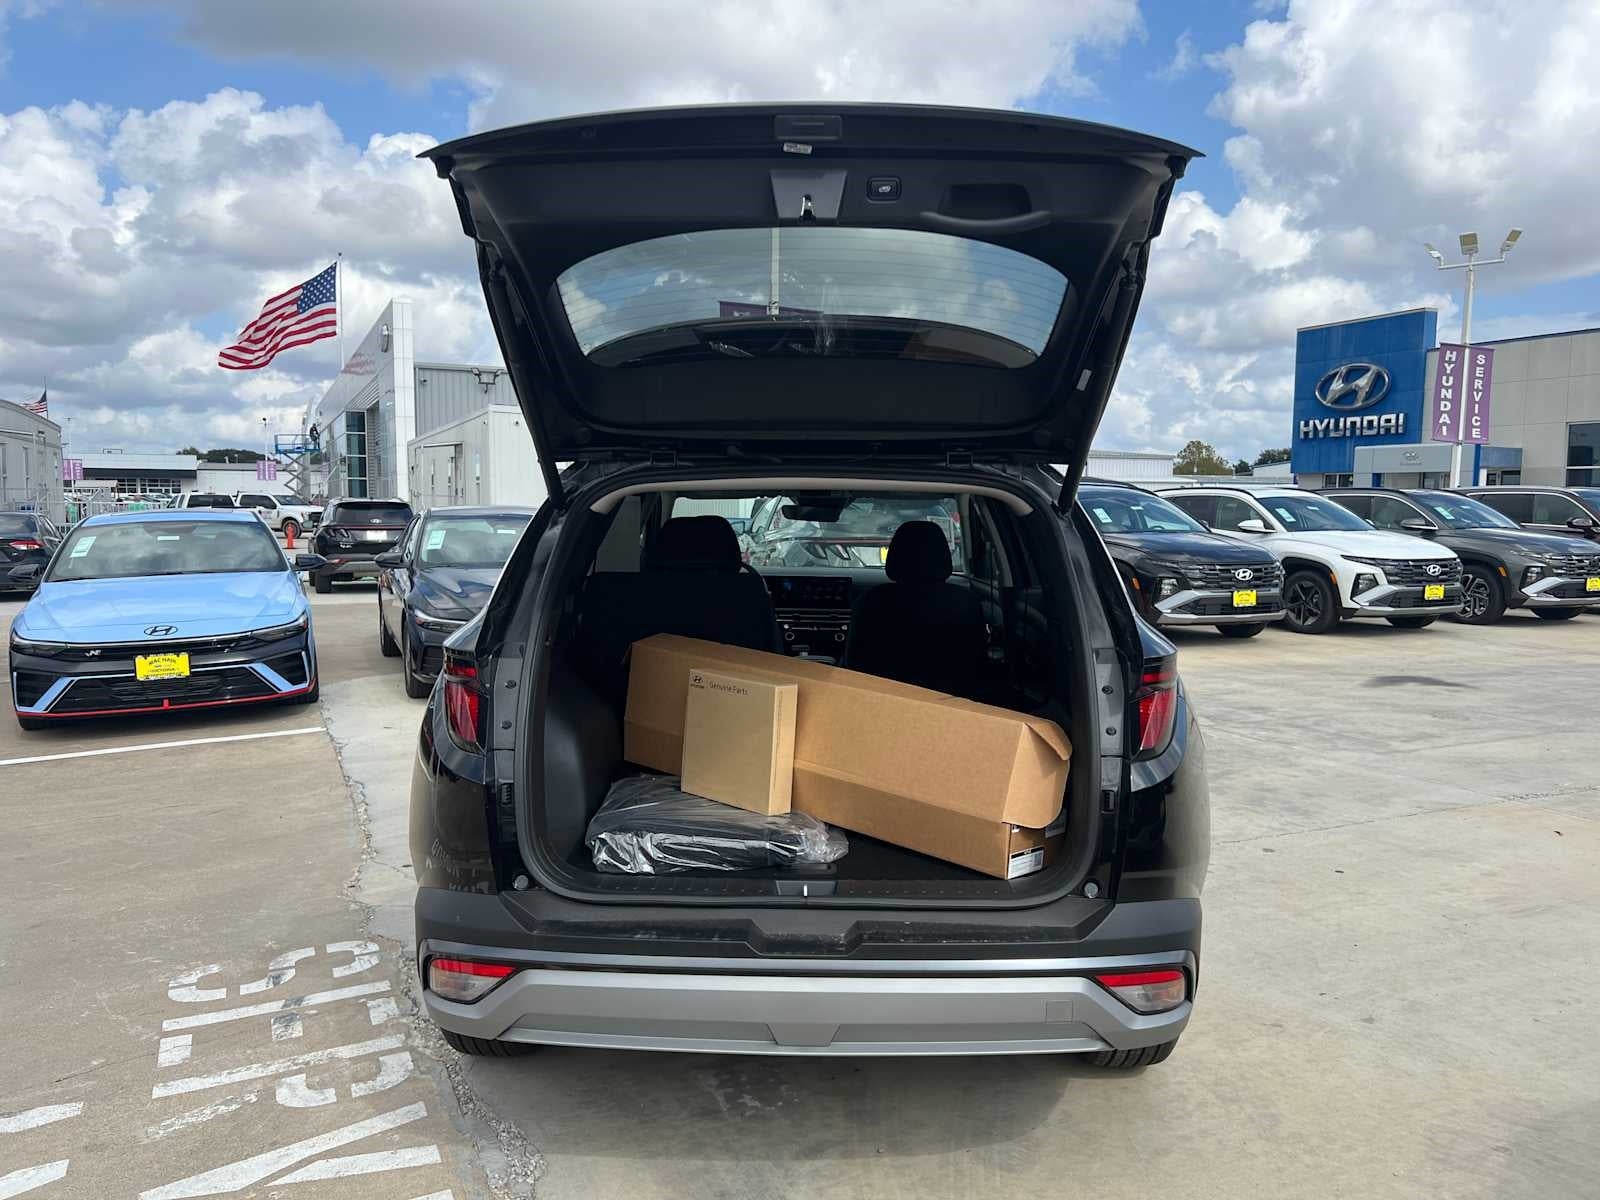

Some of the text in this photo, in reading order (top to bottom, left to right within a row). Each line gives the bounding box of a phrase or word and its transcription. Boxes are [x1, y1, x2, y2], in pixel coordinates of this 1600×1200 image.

[1299, 413, 1404, 439] HYUNDAI
[1438, 350, 1457, 436] HYUNDAI
[1471, 354, 1486, 439] SERVICE
